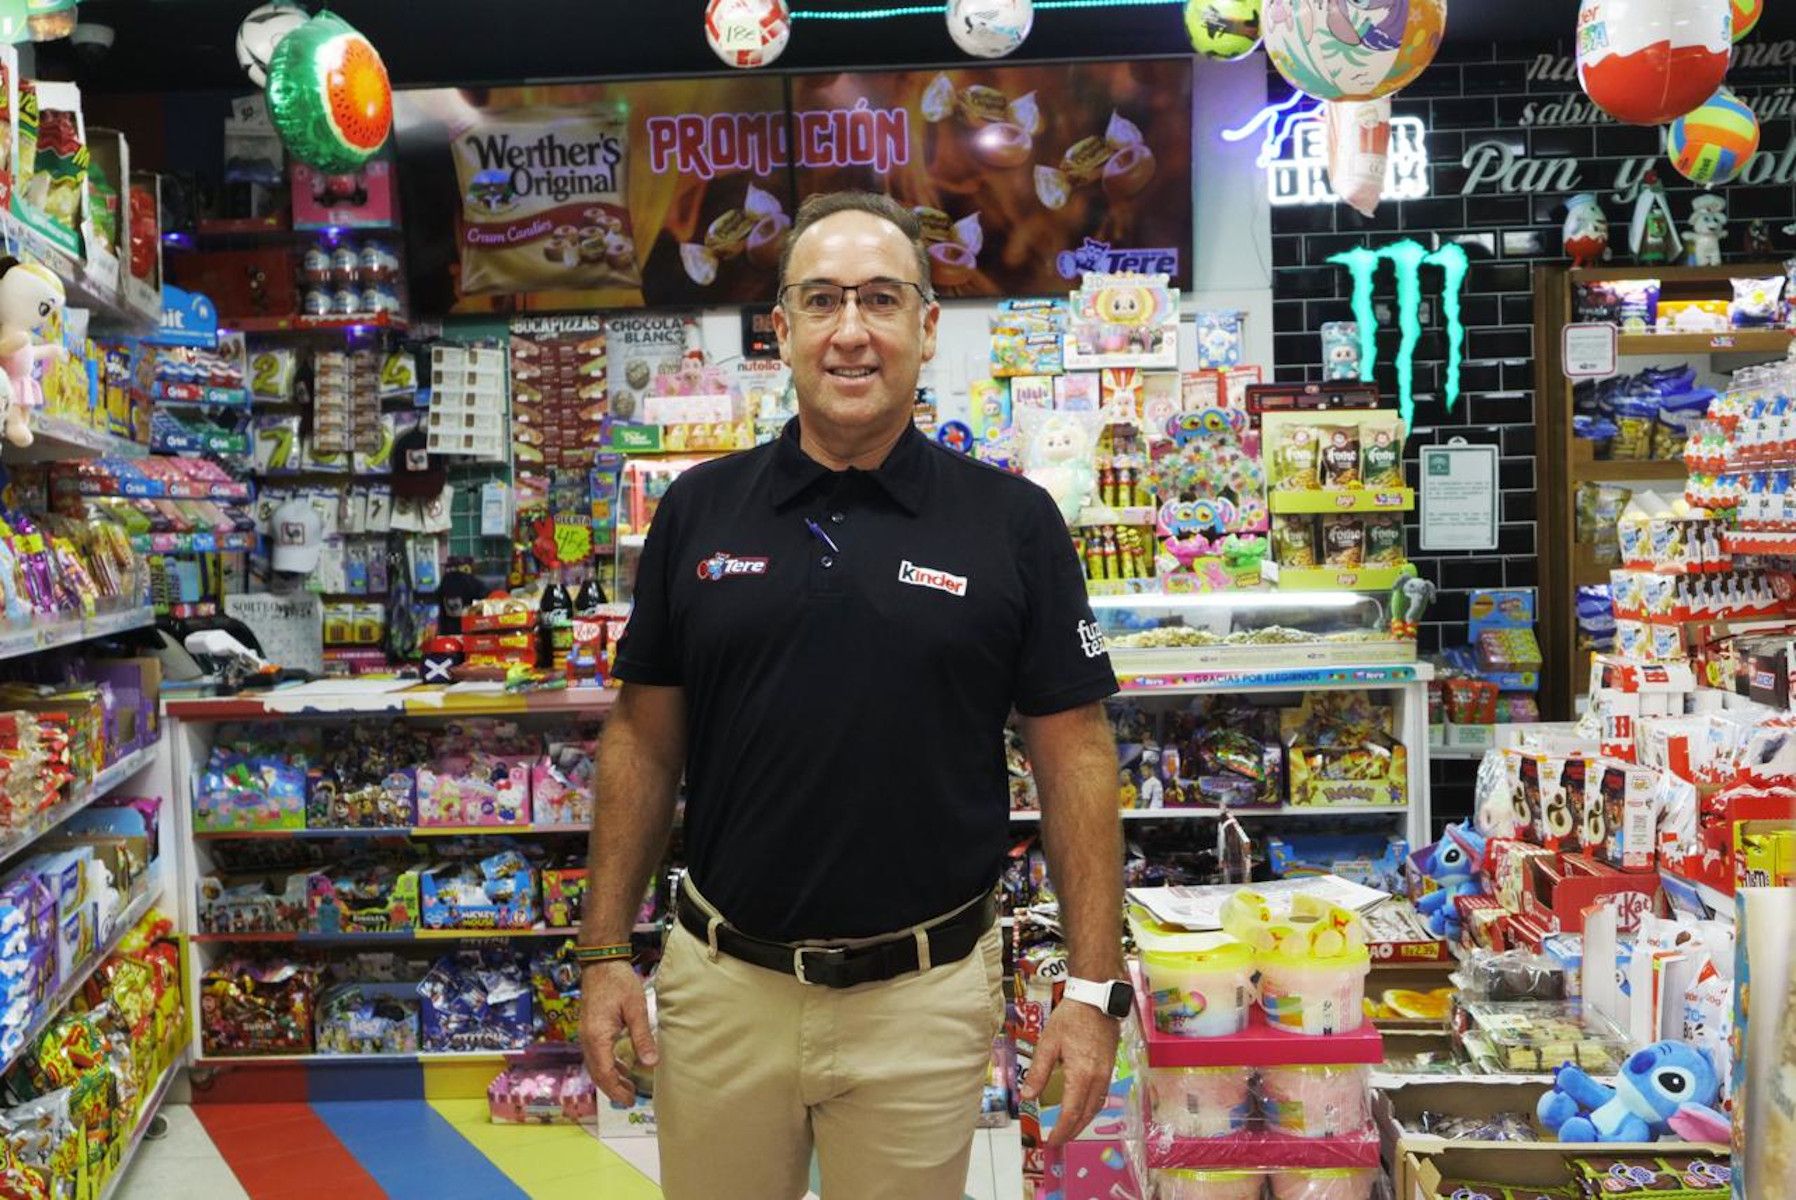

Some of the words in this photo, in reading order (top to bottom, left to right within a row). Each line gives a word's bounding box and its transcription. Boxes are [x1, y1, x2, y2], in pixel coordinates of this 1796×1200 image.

[1527, 53, 1577, 81] nu
[466, 133, 621, 170] Werther's
[648, 97, 909, 179] PROMOCIÓN
[508, 164, 617, 202] Original
[1461, 141, 1582, 195] Pan
[1611, 157, 1656, 203] y
[1106, 253, 1176, 275] Tere
[611, 317, 683, 332] CHOCOLA
[737, 361, 782, 372] nutella
[724, 557, 766, 574] Tere
[902, 562, 964, 593] kinder
